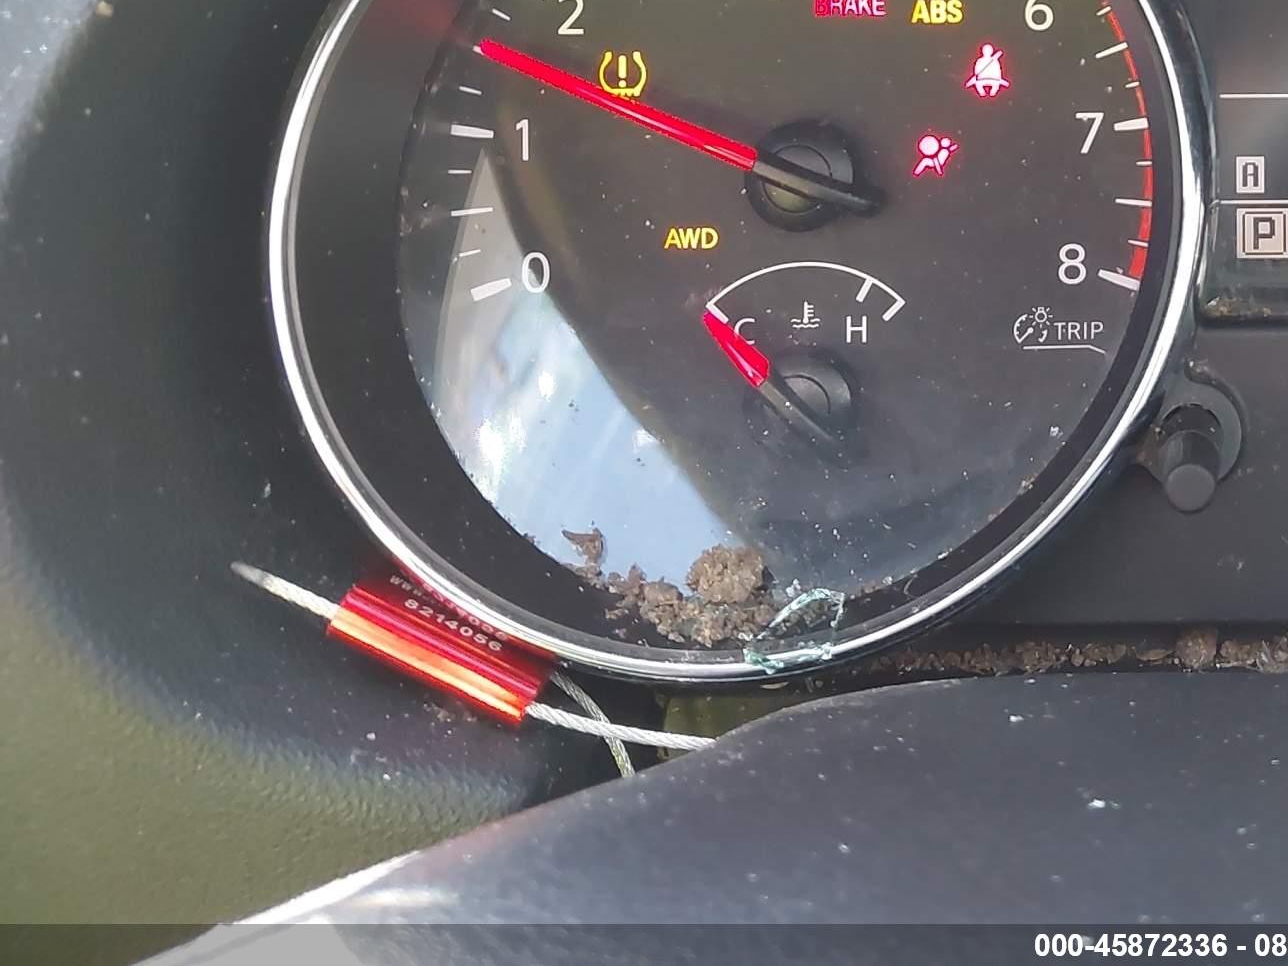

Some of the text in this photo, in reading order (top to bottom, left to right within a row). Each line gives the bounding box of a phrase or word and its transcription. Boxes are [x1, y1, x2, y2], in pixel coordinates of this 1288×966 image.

[911, 0, 963, 24] ABS
[515, 119, 529, 161] 1
[1075, 112, 1105, 154] 7
[663, 227, 719, 249] AWD
[1251, 217, 1276, 250] P
[521, 250, 551, 293] 0
[1058, 243, 1087, 285] 8
[733, 317, 756, 346] C
[846, 315, 867, 343] H
[1053, 321, 1104, 341] TRIP
[403, 598, 503, 652] 8214056
